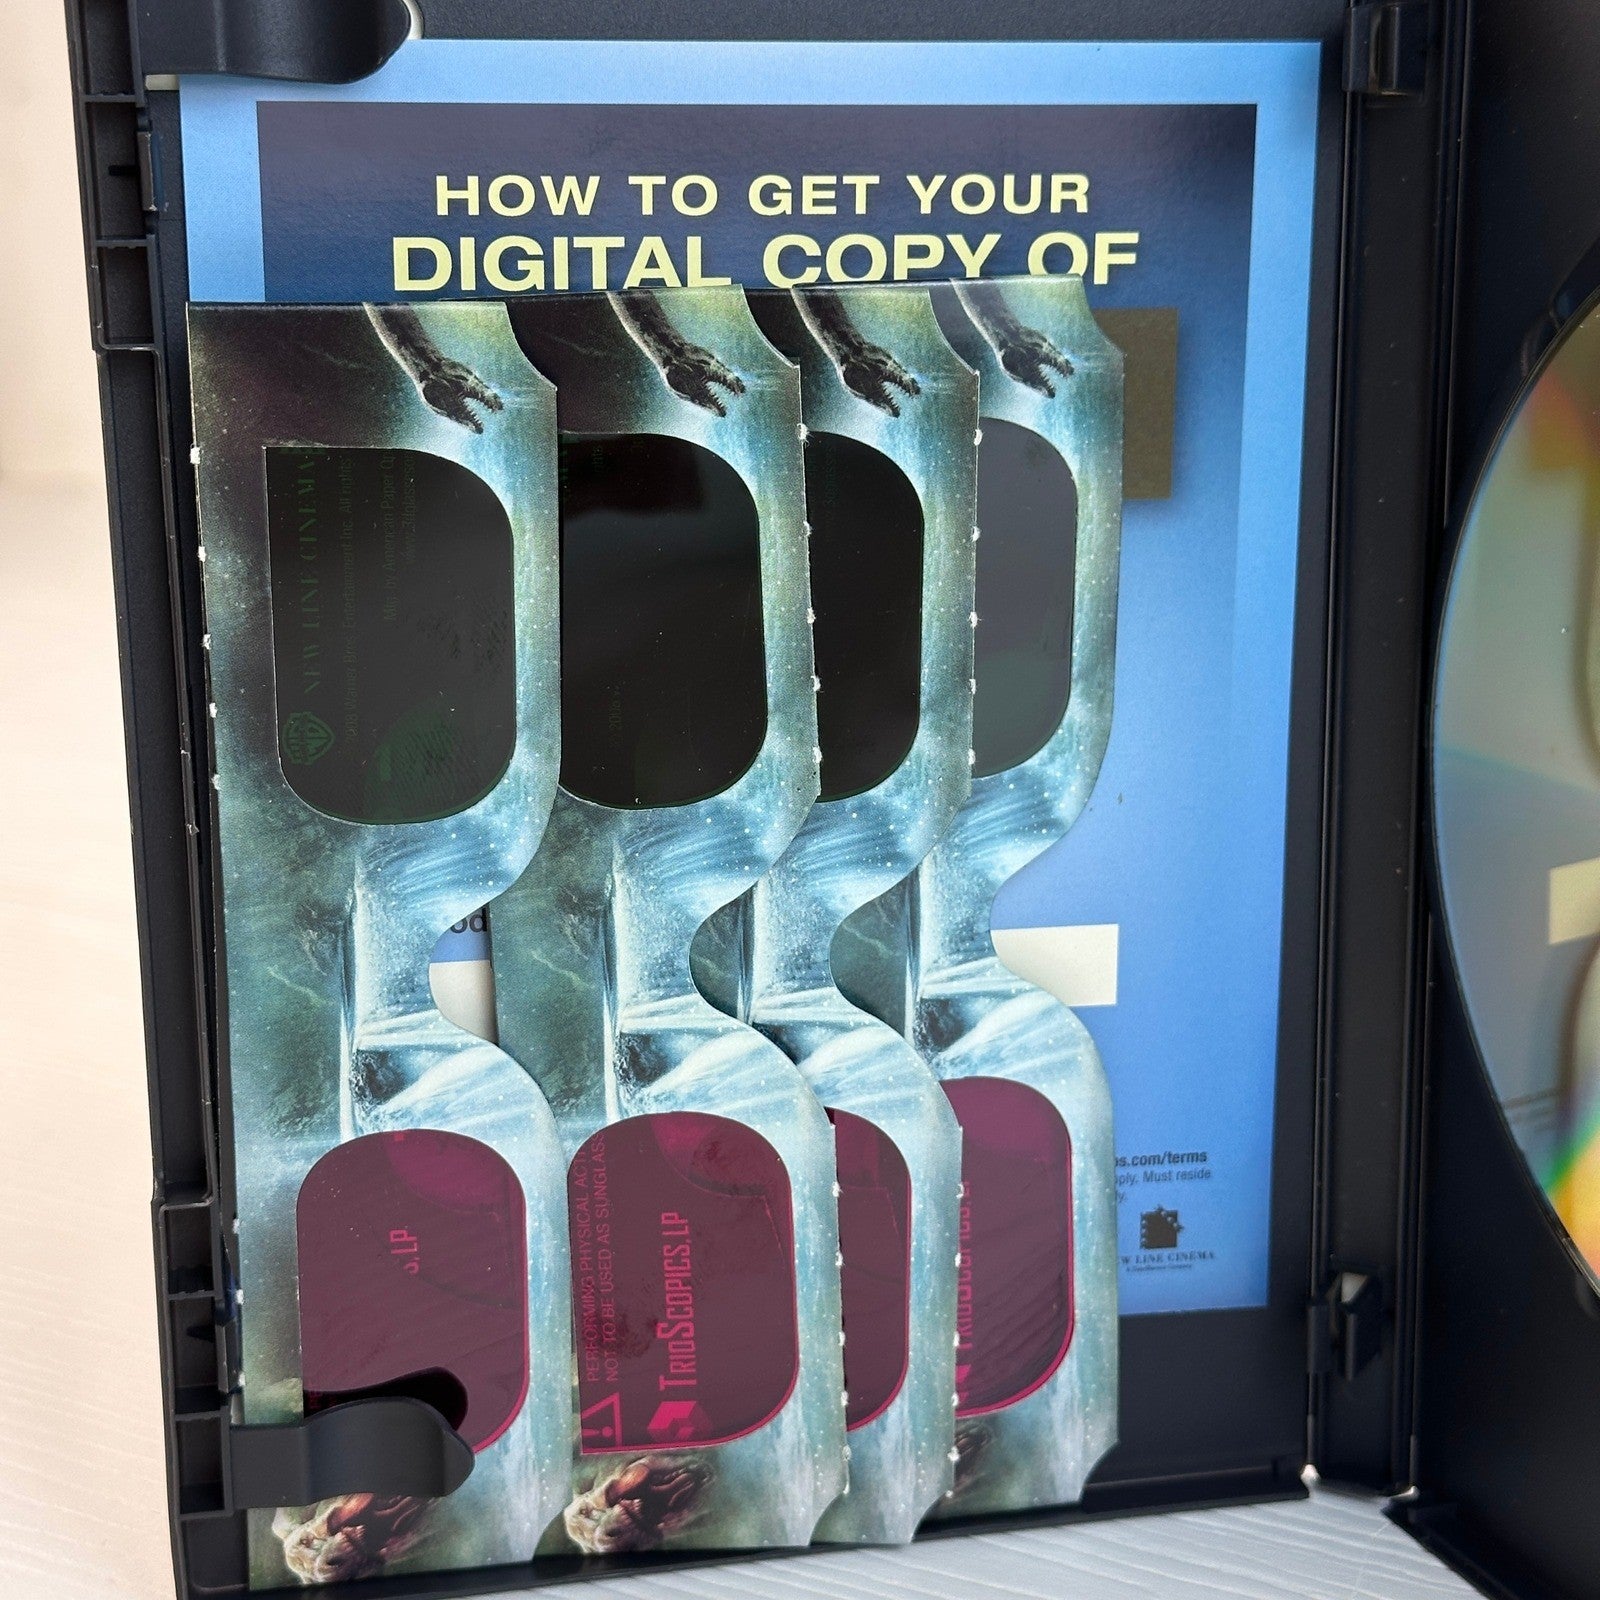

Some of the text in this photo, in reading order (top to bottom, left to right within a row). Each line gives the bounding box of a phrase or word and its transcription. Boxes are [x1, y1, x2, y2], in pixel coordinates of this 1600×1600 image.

[435, 174, 1090, 217] HOW TO GET YOUR
[393, 231, 1138, 292] DIGITAL COPY OF
[295, 460, 322, 694] NEW LINE CINEMA
[1115, 1167, 1212, 1186] ply. Must reside
[576, 1193, 594, 1271] PHYSICAL
[595, 1223, 610, 1244] AS
[661, 1212, 690, 1237] LP
[389, 1229, 419, 1254] LP
[596, 1249, 613, 1292] USED
[600, 1297, 616, 1318] BE
[581, 1276, 601, 1382] PERFORMING
[602, 1322, 617, 1344] TO
[604, 1350, 618, 1382] NOT
